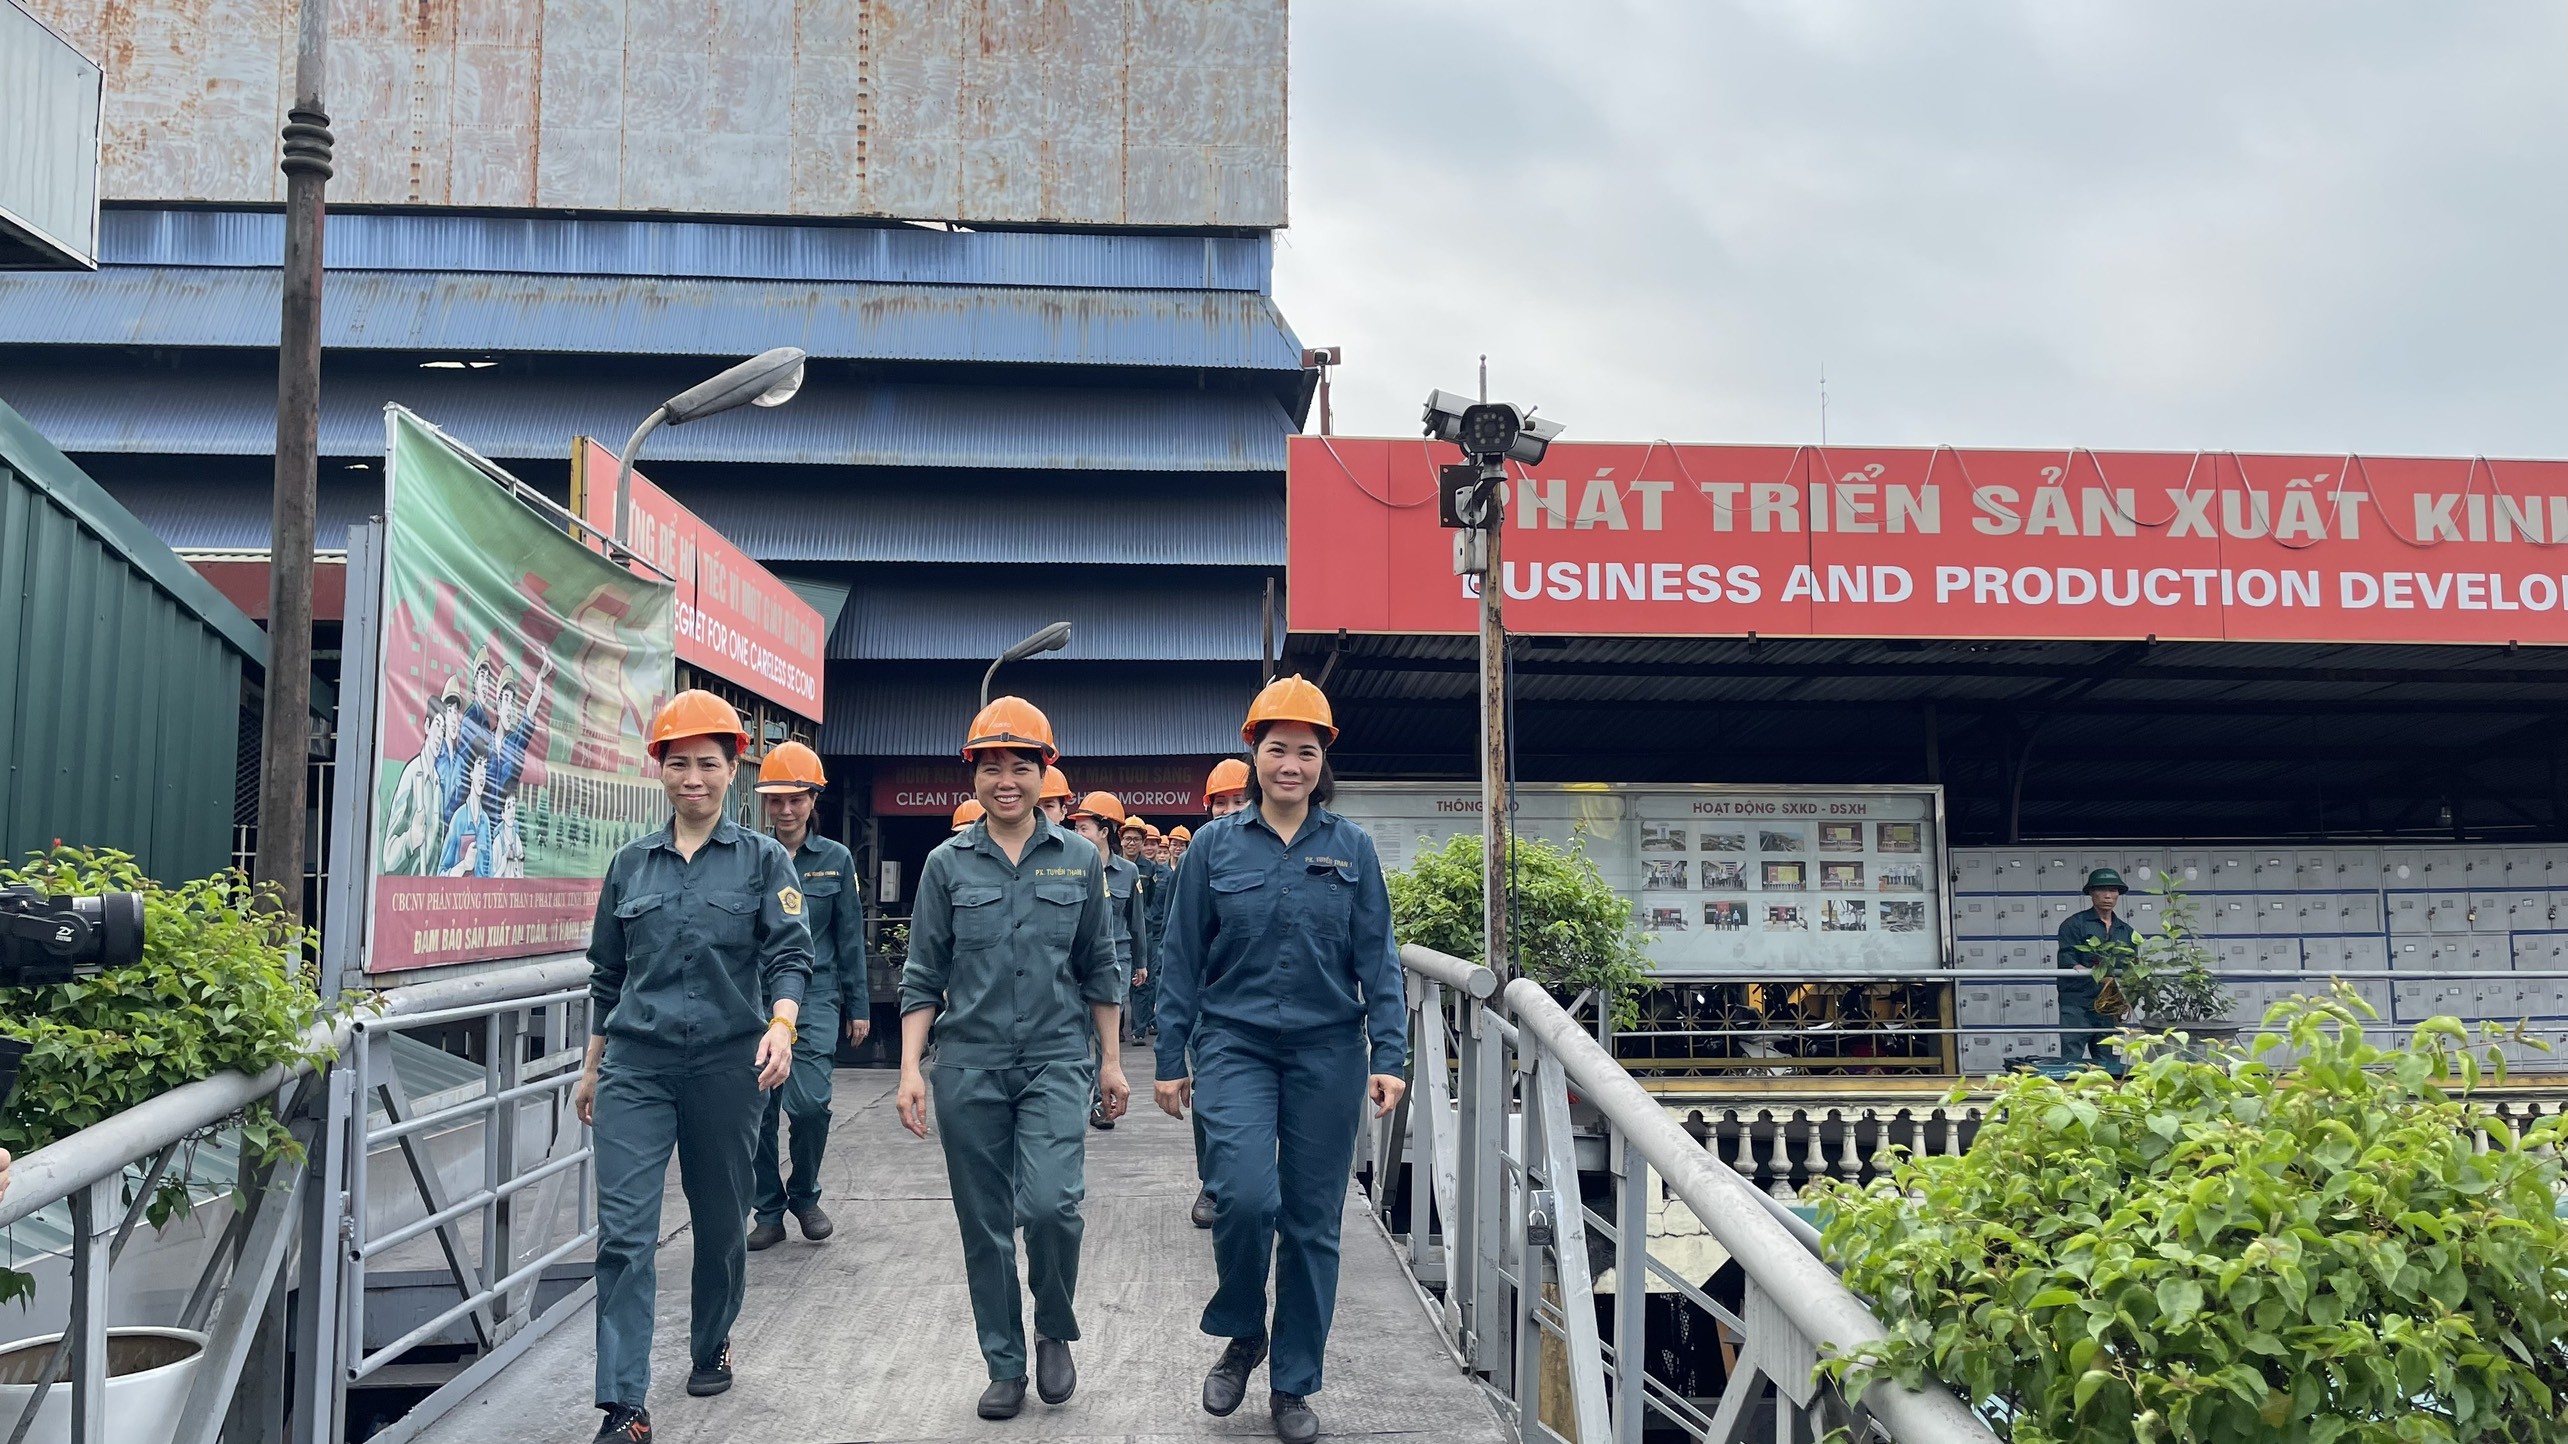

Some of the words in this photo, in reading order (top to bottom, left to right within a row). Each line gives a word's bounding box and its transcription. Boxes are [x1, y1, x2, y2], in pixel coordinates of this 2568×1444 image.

[1500, 467, 1674, 531] HÁT
[1700, 464, 1941, 534] TRIỂN
[1971, 466, 2138, 536] SẢN
[2164, 473, 2369, 541] XUẤT
[1462, 561, 1763, 603] USINESS
[1779, 564, 1914, 603] AND
[1935, 565, 2321, 608] PRODUCTION
[2339, 570, 2568, 611] DEVELO
[707, 616, 727, 656] FOR
[729, 629, 749, 667] ONE
[750, 642, 787, 687] CARELESS
[896, 791, 947, 806] CLEAN
[1115, 791, 1191, 805] MORROW
[1436, 798, 1483, 812] THÔNG
[1693, 802, 1731, 816] HOẠT
[1734, 800, 1776, 816] ĐỘNG
[1782, 803, 1818, 814] SXKD
[1829, 803, 1867, 814] ĐSXH
[392, 892, 425, 911] CBCNV
[413, 919, 440, 955] ĐẢM
[441, 918, 463, 951] BẢO
[464, 917, 485, 950] SẢN
